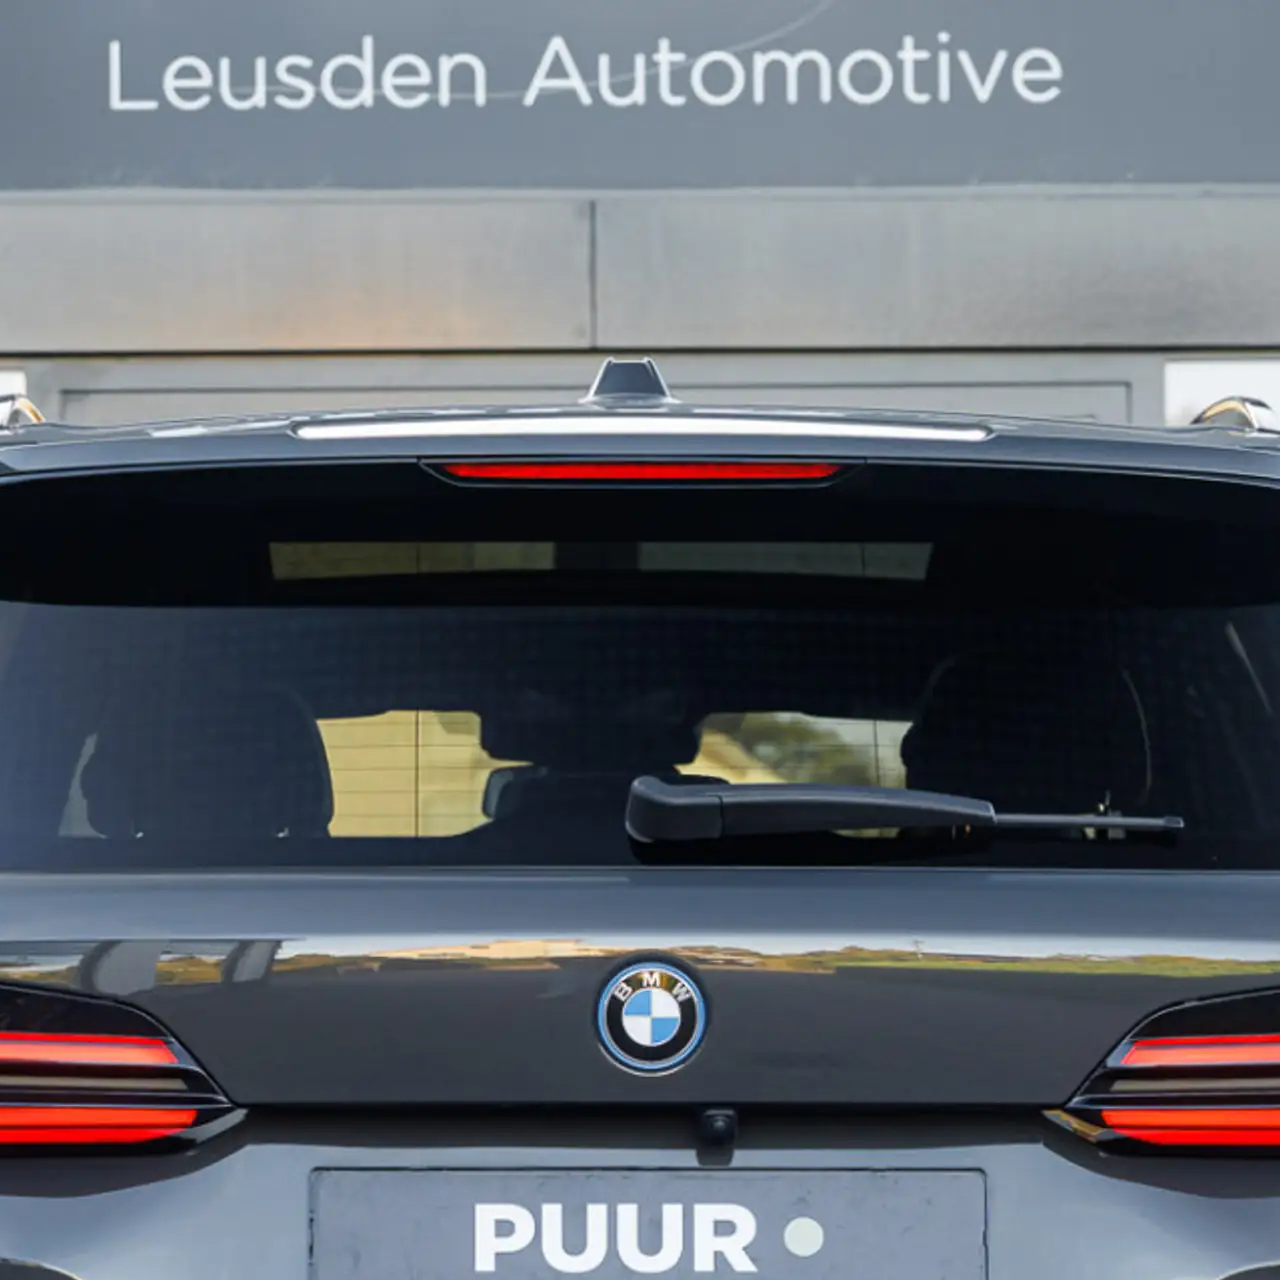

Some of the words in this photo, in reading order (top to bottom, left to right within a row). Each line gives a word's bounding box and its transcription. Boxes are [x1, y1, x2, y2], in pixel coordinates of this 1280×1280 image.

[109, 34, 487, 110] Leusden
[524, 32, 1063, 107] Automotive
[614, 970, 691, 1002] BMW
[474, 1203, 758, 1272] PUUR
